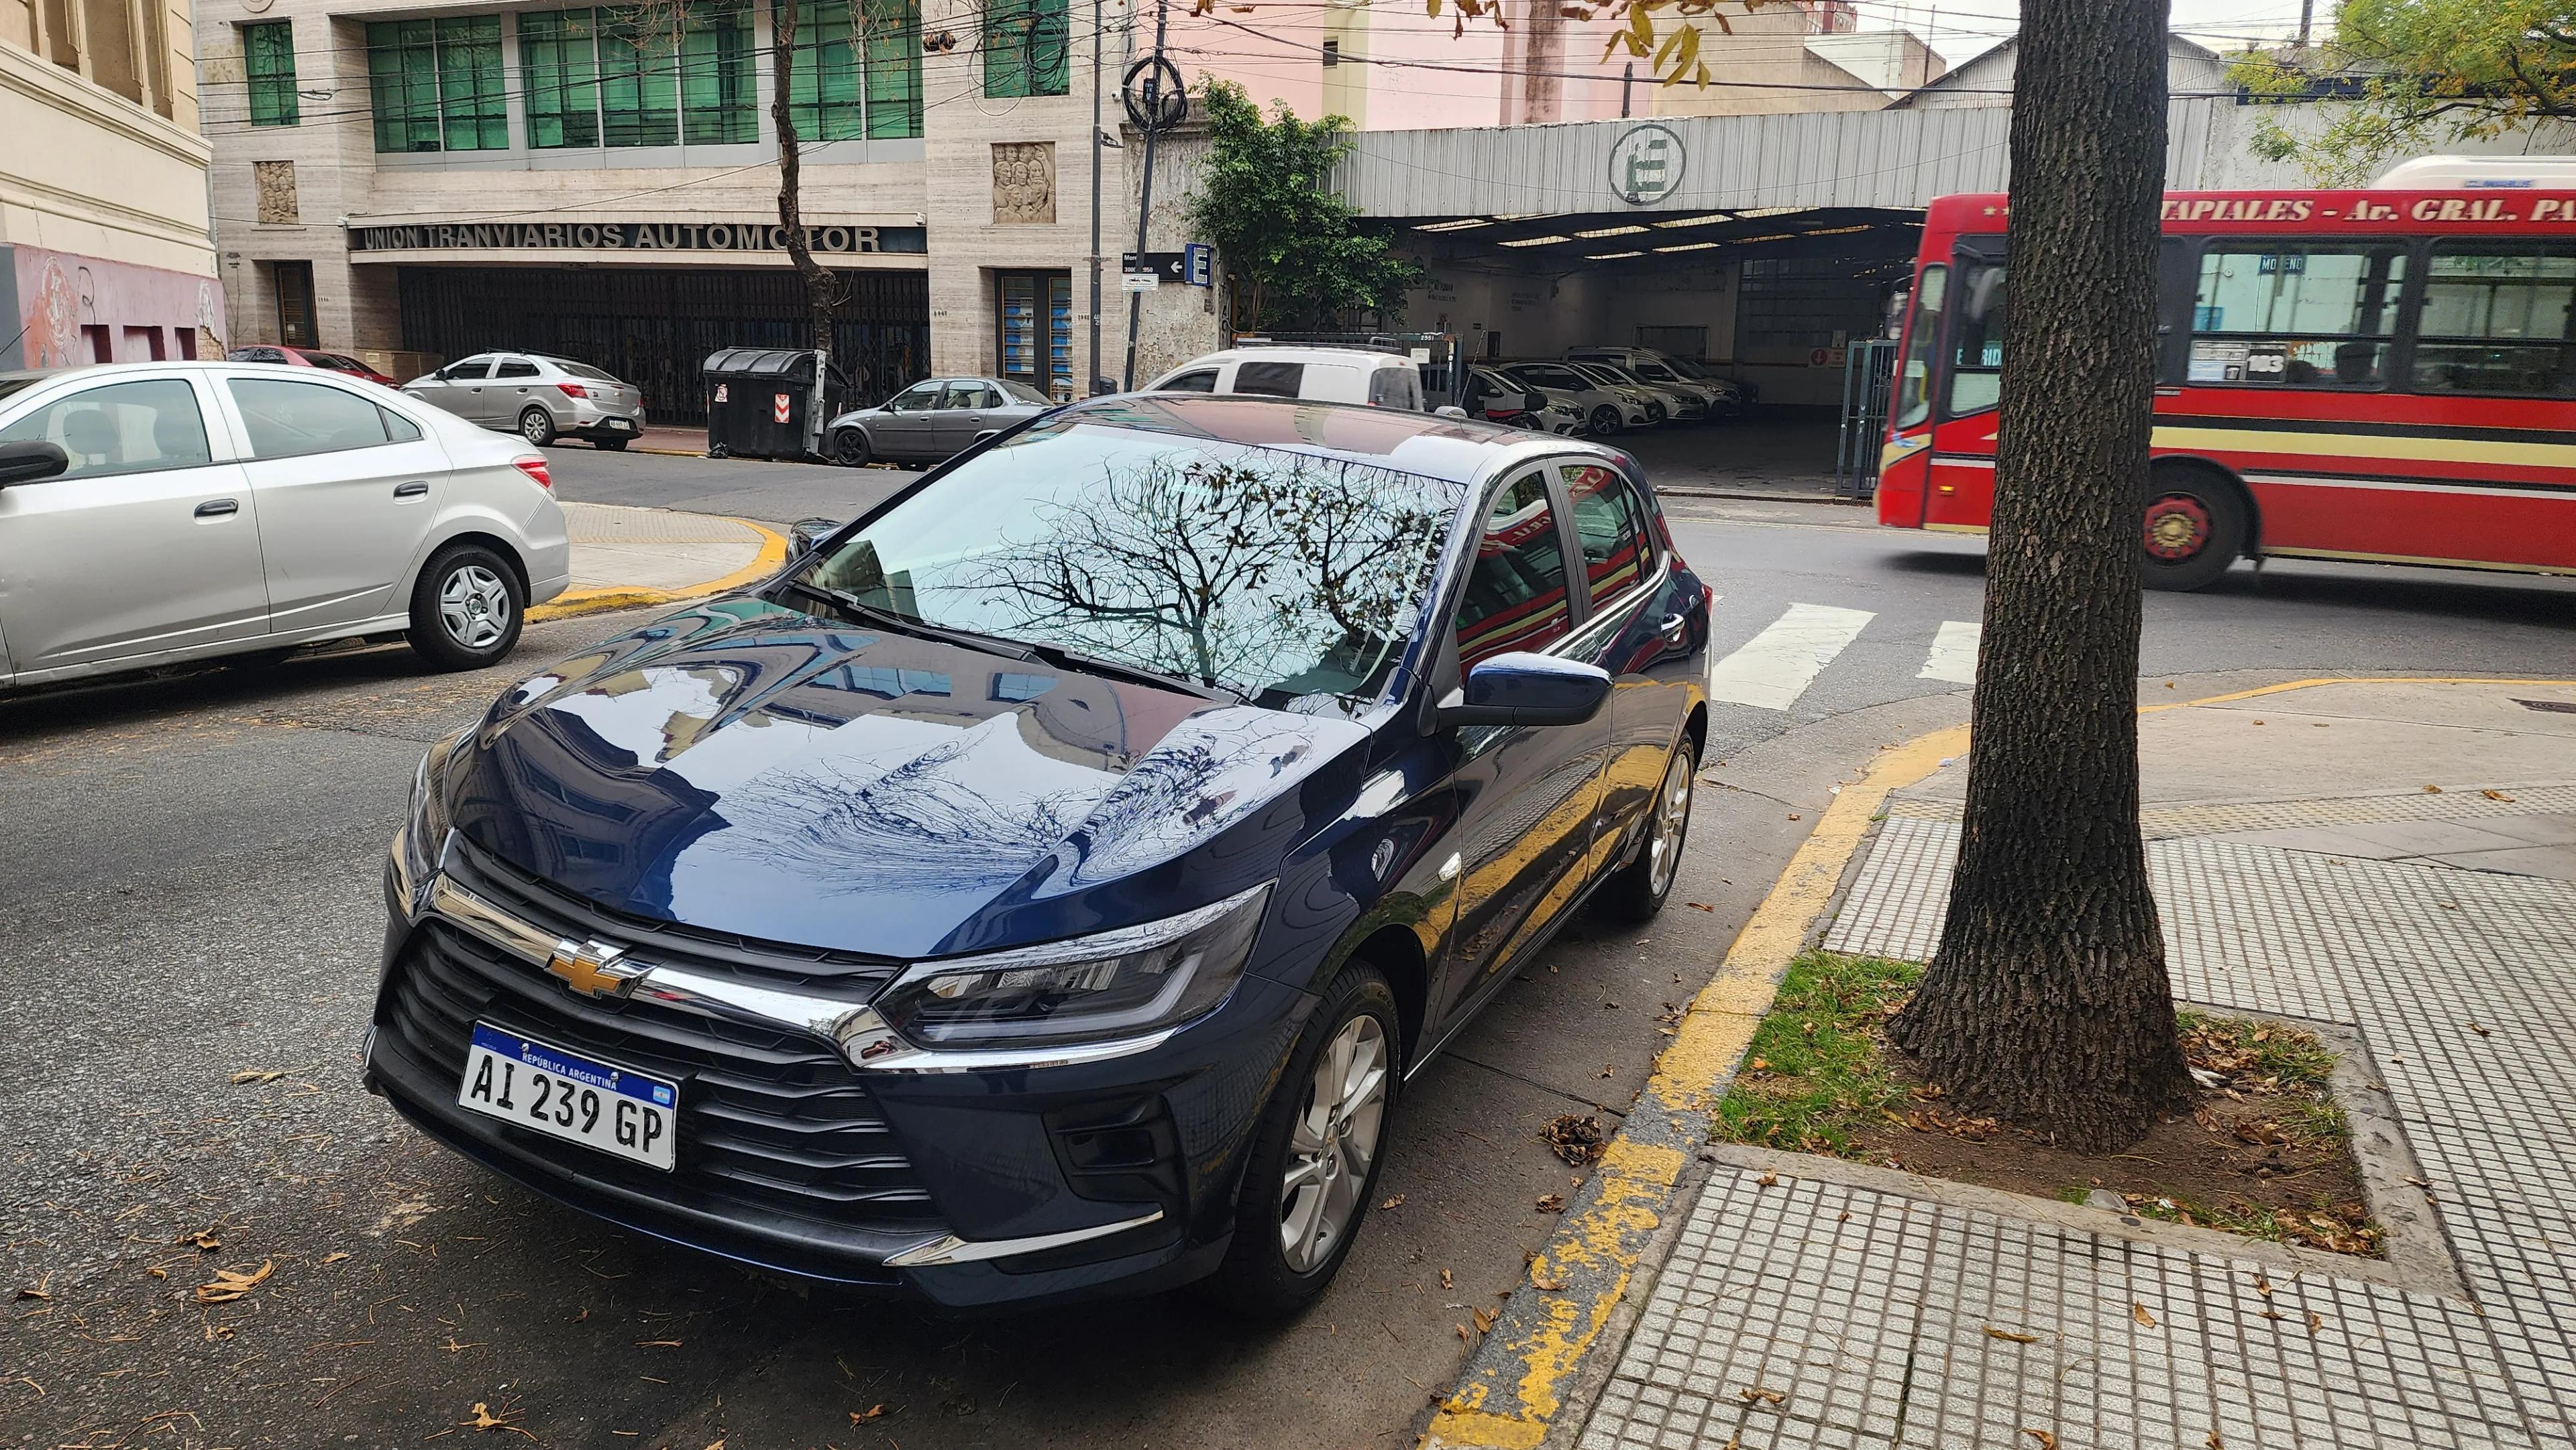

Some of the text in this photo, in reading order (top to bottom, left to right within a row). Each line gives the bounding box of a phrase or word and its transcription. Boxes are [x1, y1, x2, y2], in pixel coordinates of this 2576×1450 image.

[1626, 139, 1668, 192] E
[2344, 199, 2400, 221] Av.
[2411, 200, 2518, 221] GRAL.
[364, 223, 881, 252] UNION TRANVIARIOS AUTOMOTOR
[1193, 247, 1208, 283] E
[2261, 258, 2303, 270] MOENO
[521, 1052, 566, 1075] REPÚBLICA
[568, 1068, 617, 1091] ARGENTINA
[470, 1054, 662, 1153] AI 239 GP
